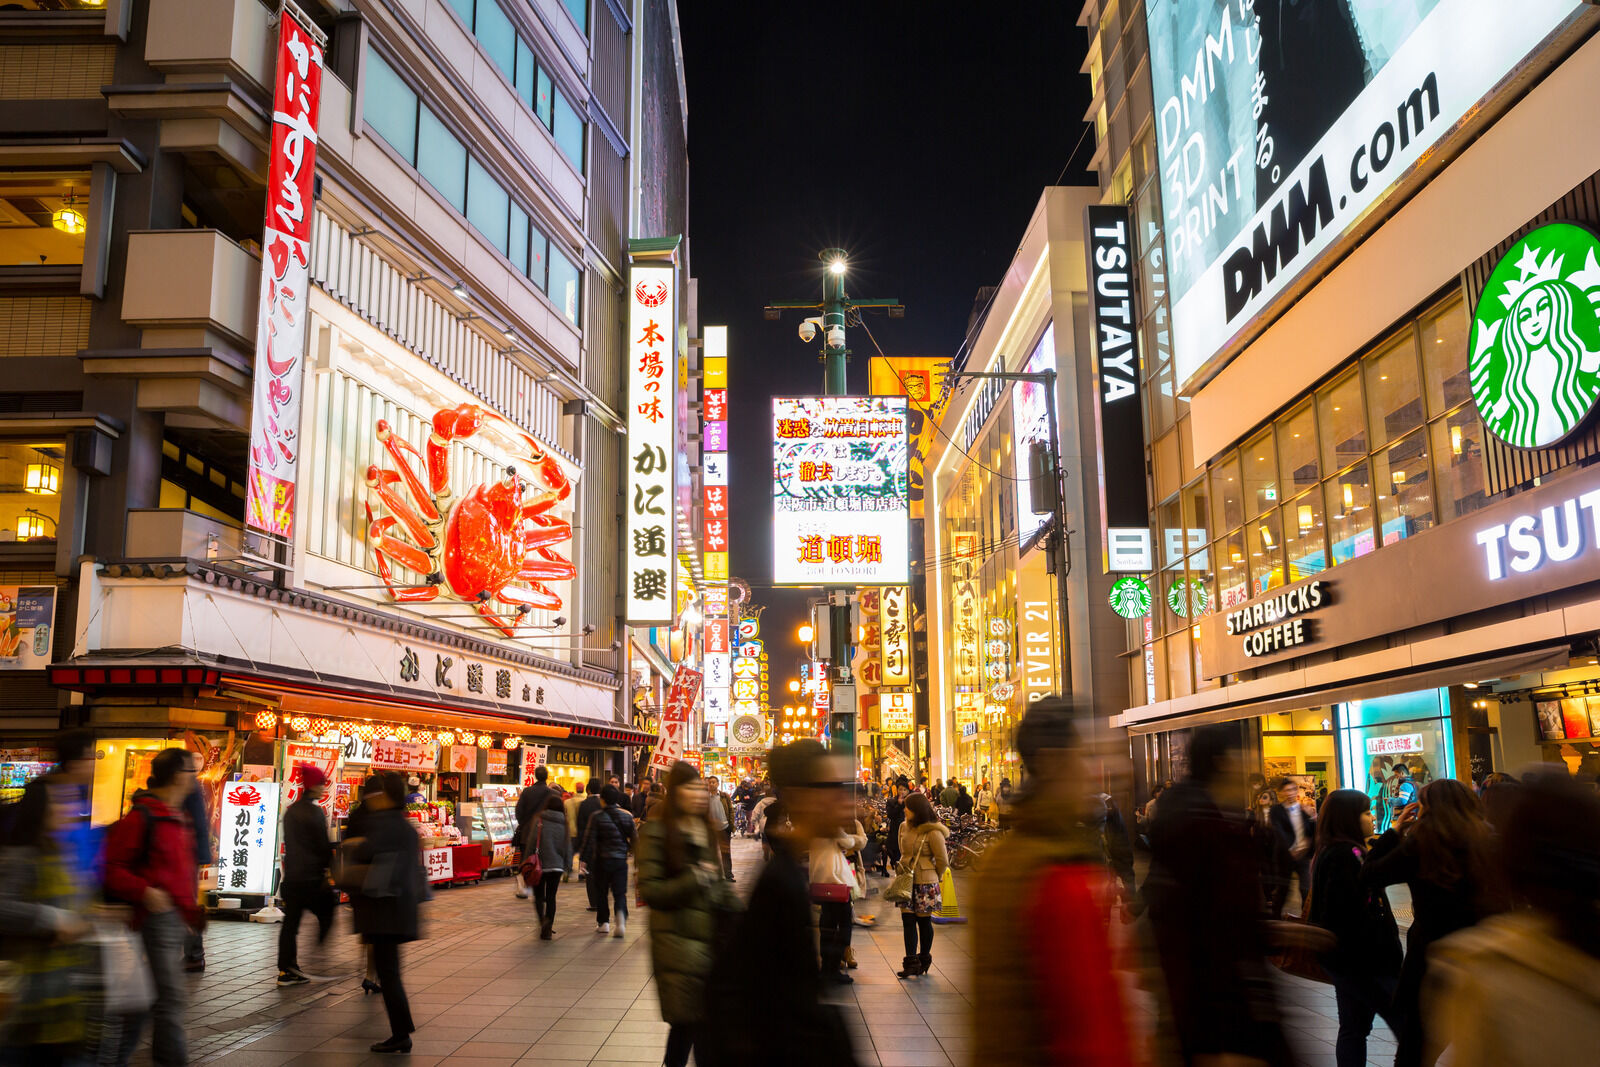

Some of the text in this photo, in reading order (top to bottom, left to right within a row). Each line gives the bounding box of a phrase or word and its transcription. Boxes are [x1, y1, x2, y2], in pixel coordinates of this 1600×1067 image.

[1160, 3, 1235, 161] DMM
[273, 28, 323, 233] かにすき
[1166, 131, 1206, 221] 3D
[1170, 144, 1245, 275] PRINT
[1222, 71, 1441, 325] DMM.com
[1095, 221, 1136, 403] TSUTAYA
[637, 319, 665, 424] 本場の味
[776, 417, 903, 438] 迷惑な放置自転車
[799, 460, 882, 482] 撤去します。
[706, 487, 725, 517] はや
[706, 520, 725, 551] はや
[797, 533, 882, 564] 道頓堀
[1025, 601, 1049, 621] 21
[1226, 581, 1323, 636] STARBUCKS
[710, 622, 724, 651] 白木屋
[1242, 619, 1305, 657] COFFEE
[374, 746, 434, 766] お土産コーナー
[428, 864, 450, 876] コーナー
[429, 852, 448, 865] お土産
